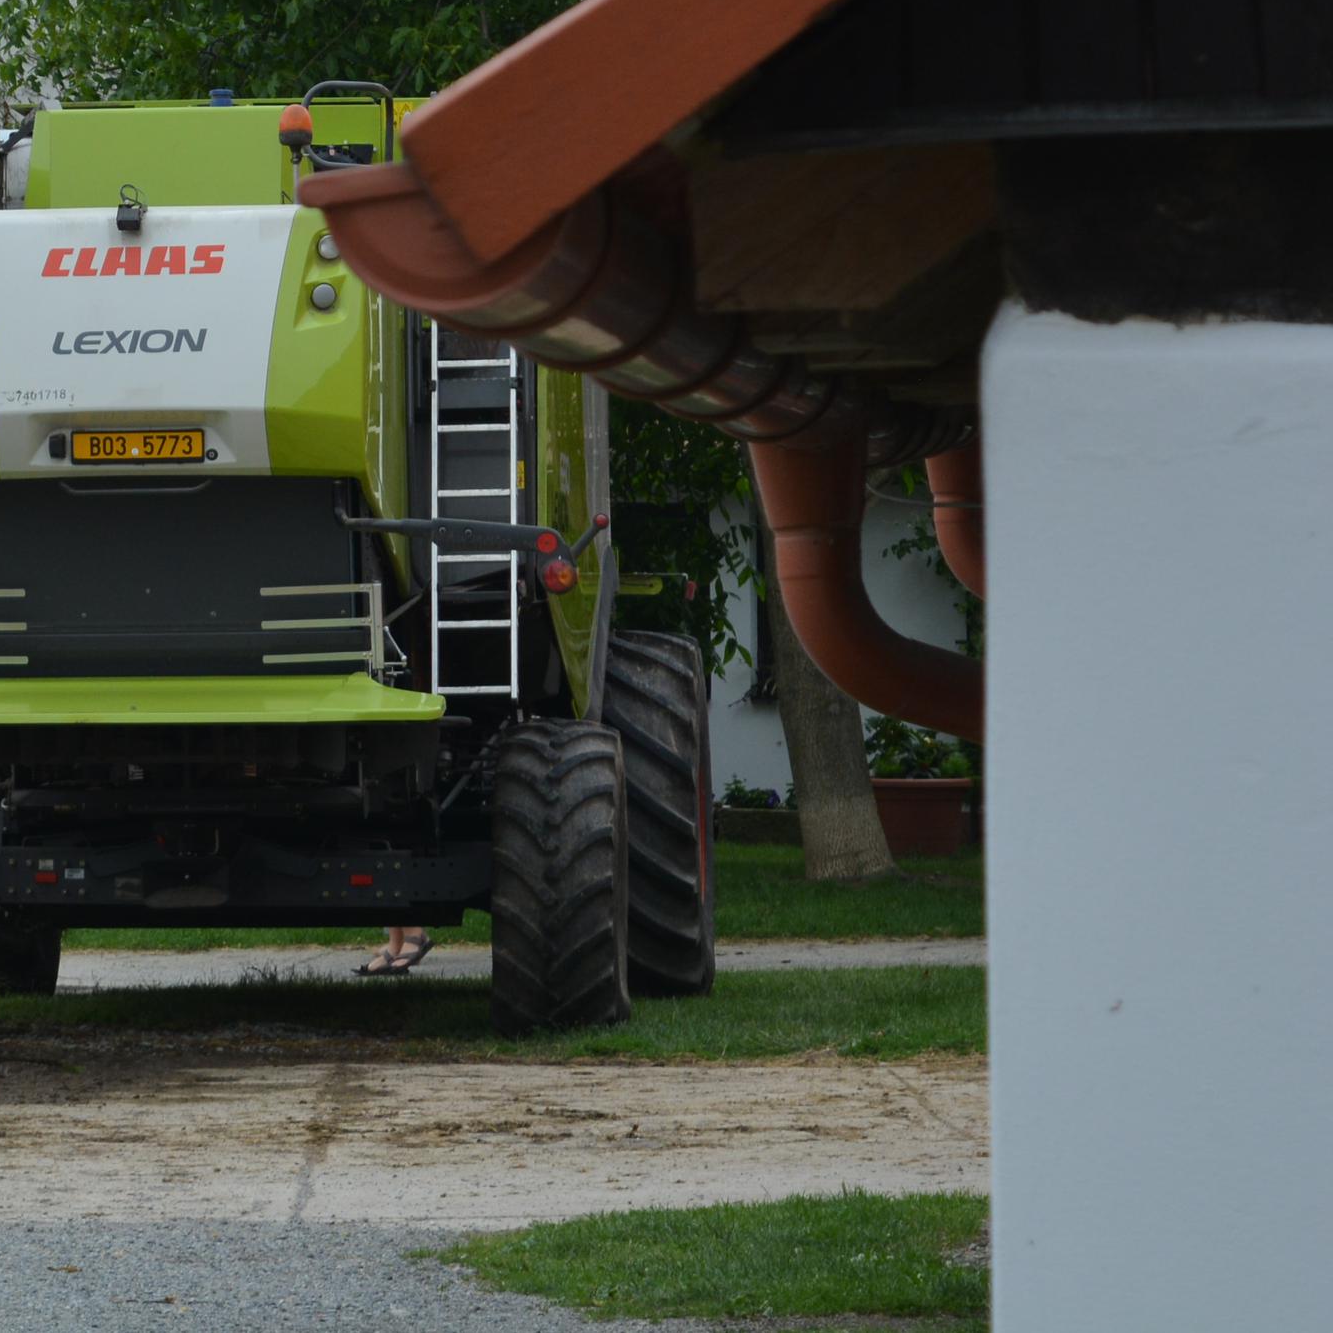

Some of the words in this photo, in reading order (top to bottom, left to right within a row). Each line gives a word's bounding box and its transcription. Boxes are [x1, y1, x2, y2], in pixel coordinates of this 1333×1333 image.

[41, 244, 226, 278] CLAAS
[52, 328, 208, 355] LEXION
[142, 435, 193, 456] 5773
